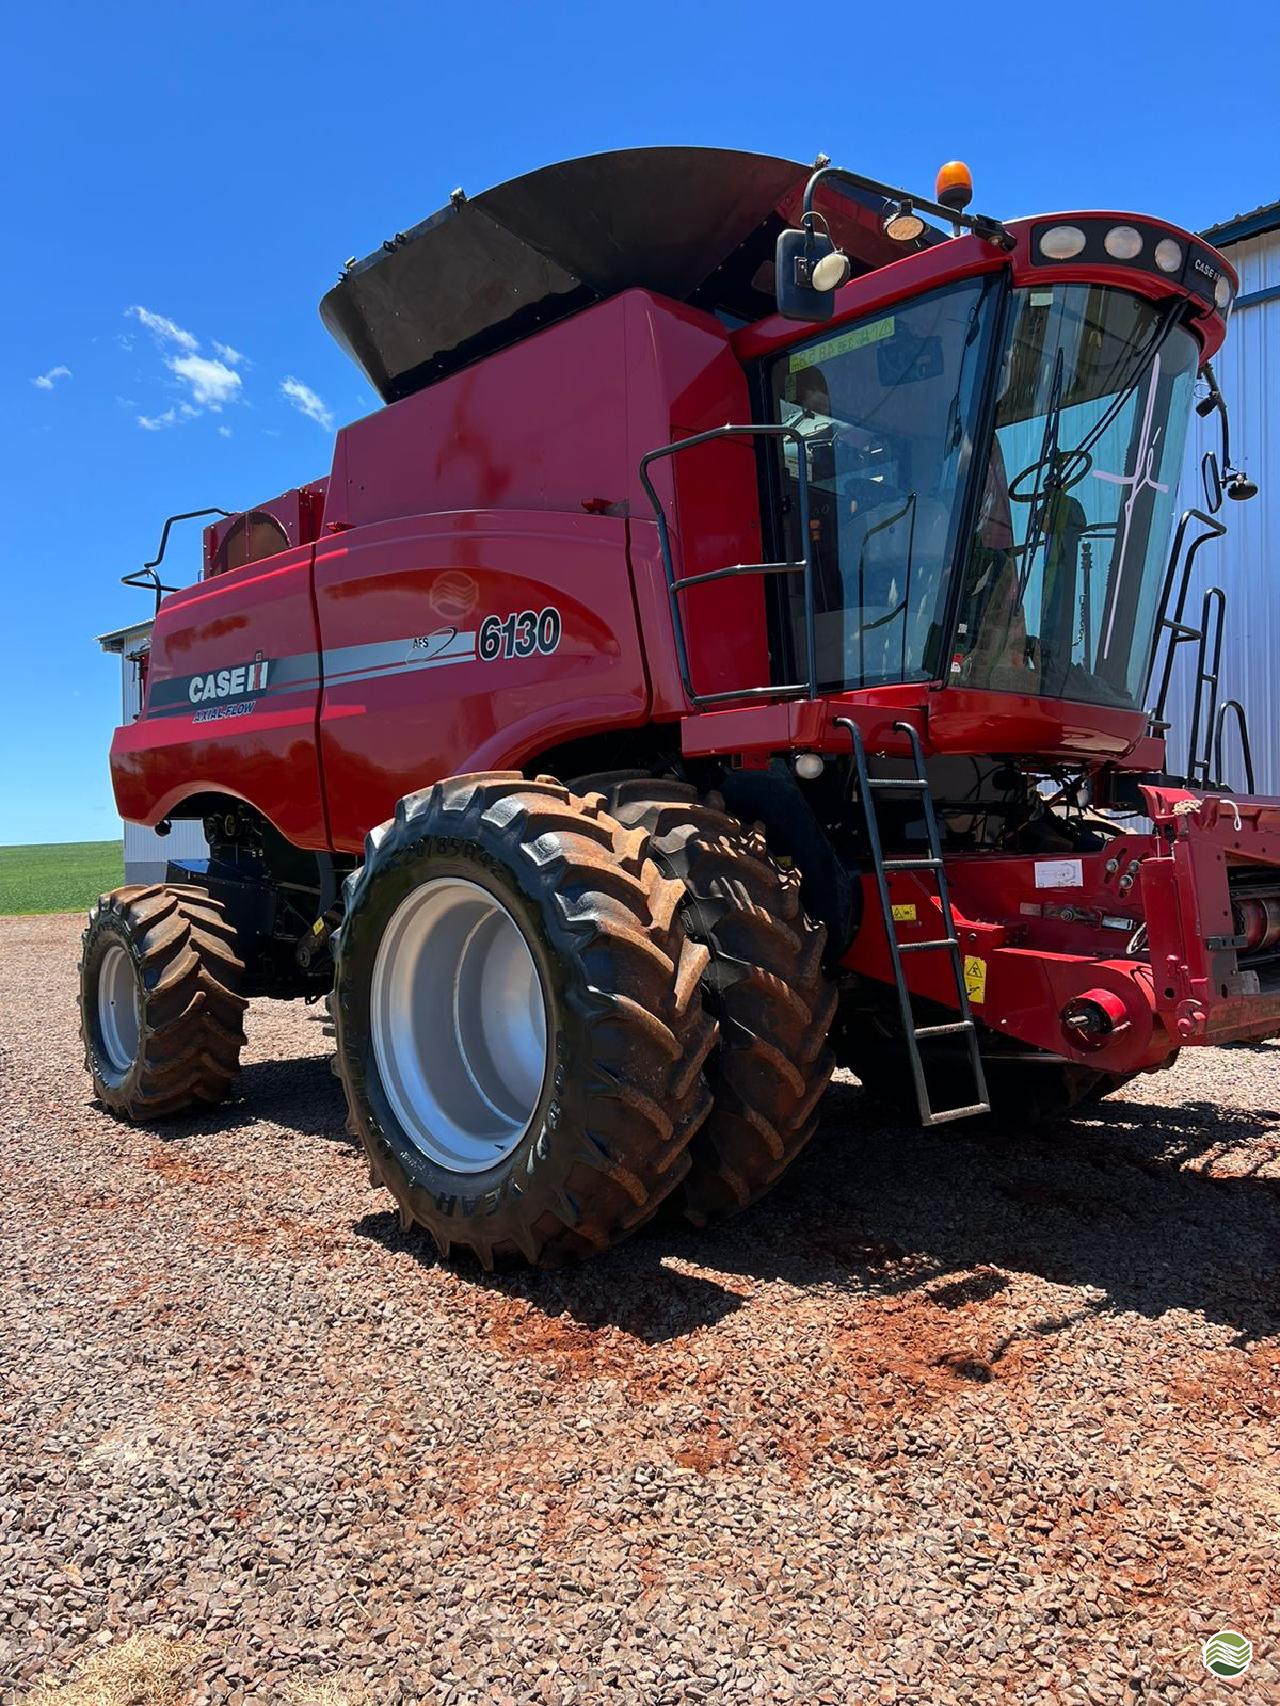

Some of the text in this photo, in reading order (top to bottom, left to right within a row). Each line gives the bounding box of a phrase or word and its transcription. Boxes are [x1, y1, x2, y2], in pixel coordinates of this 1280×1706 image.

[1194, 258, 1215, 278] CASE
[412, 637, 429, 649] AFS
[478, 606, 562, 661] 6130
[188, 666, 246, 703] CASE
[192, 700, 256, 724] AXIAL-FLOW
